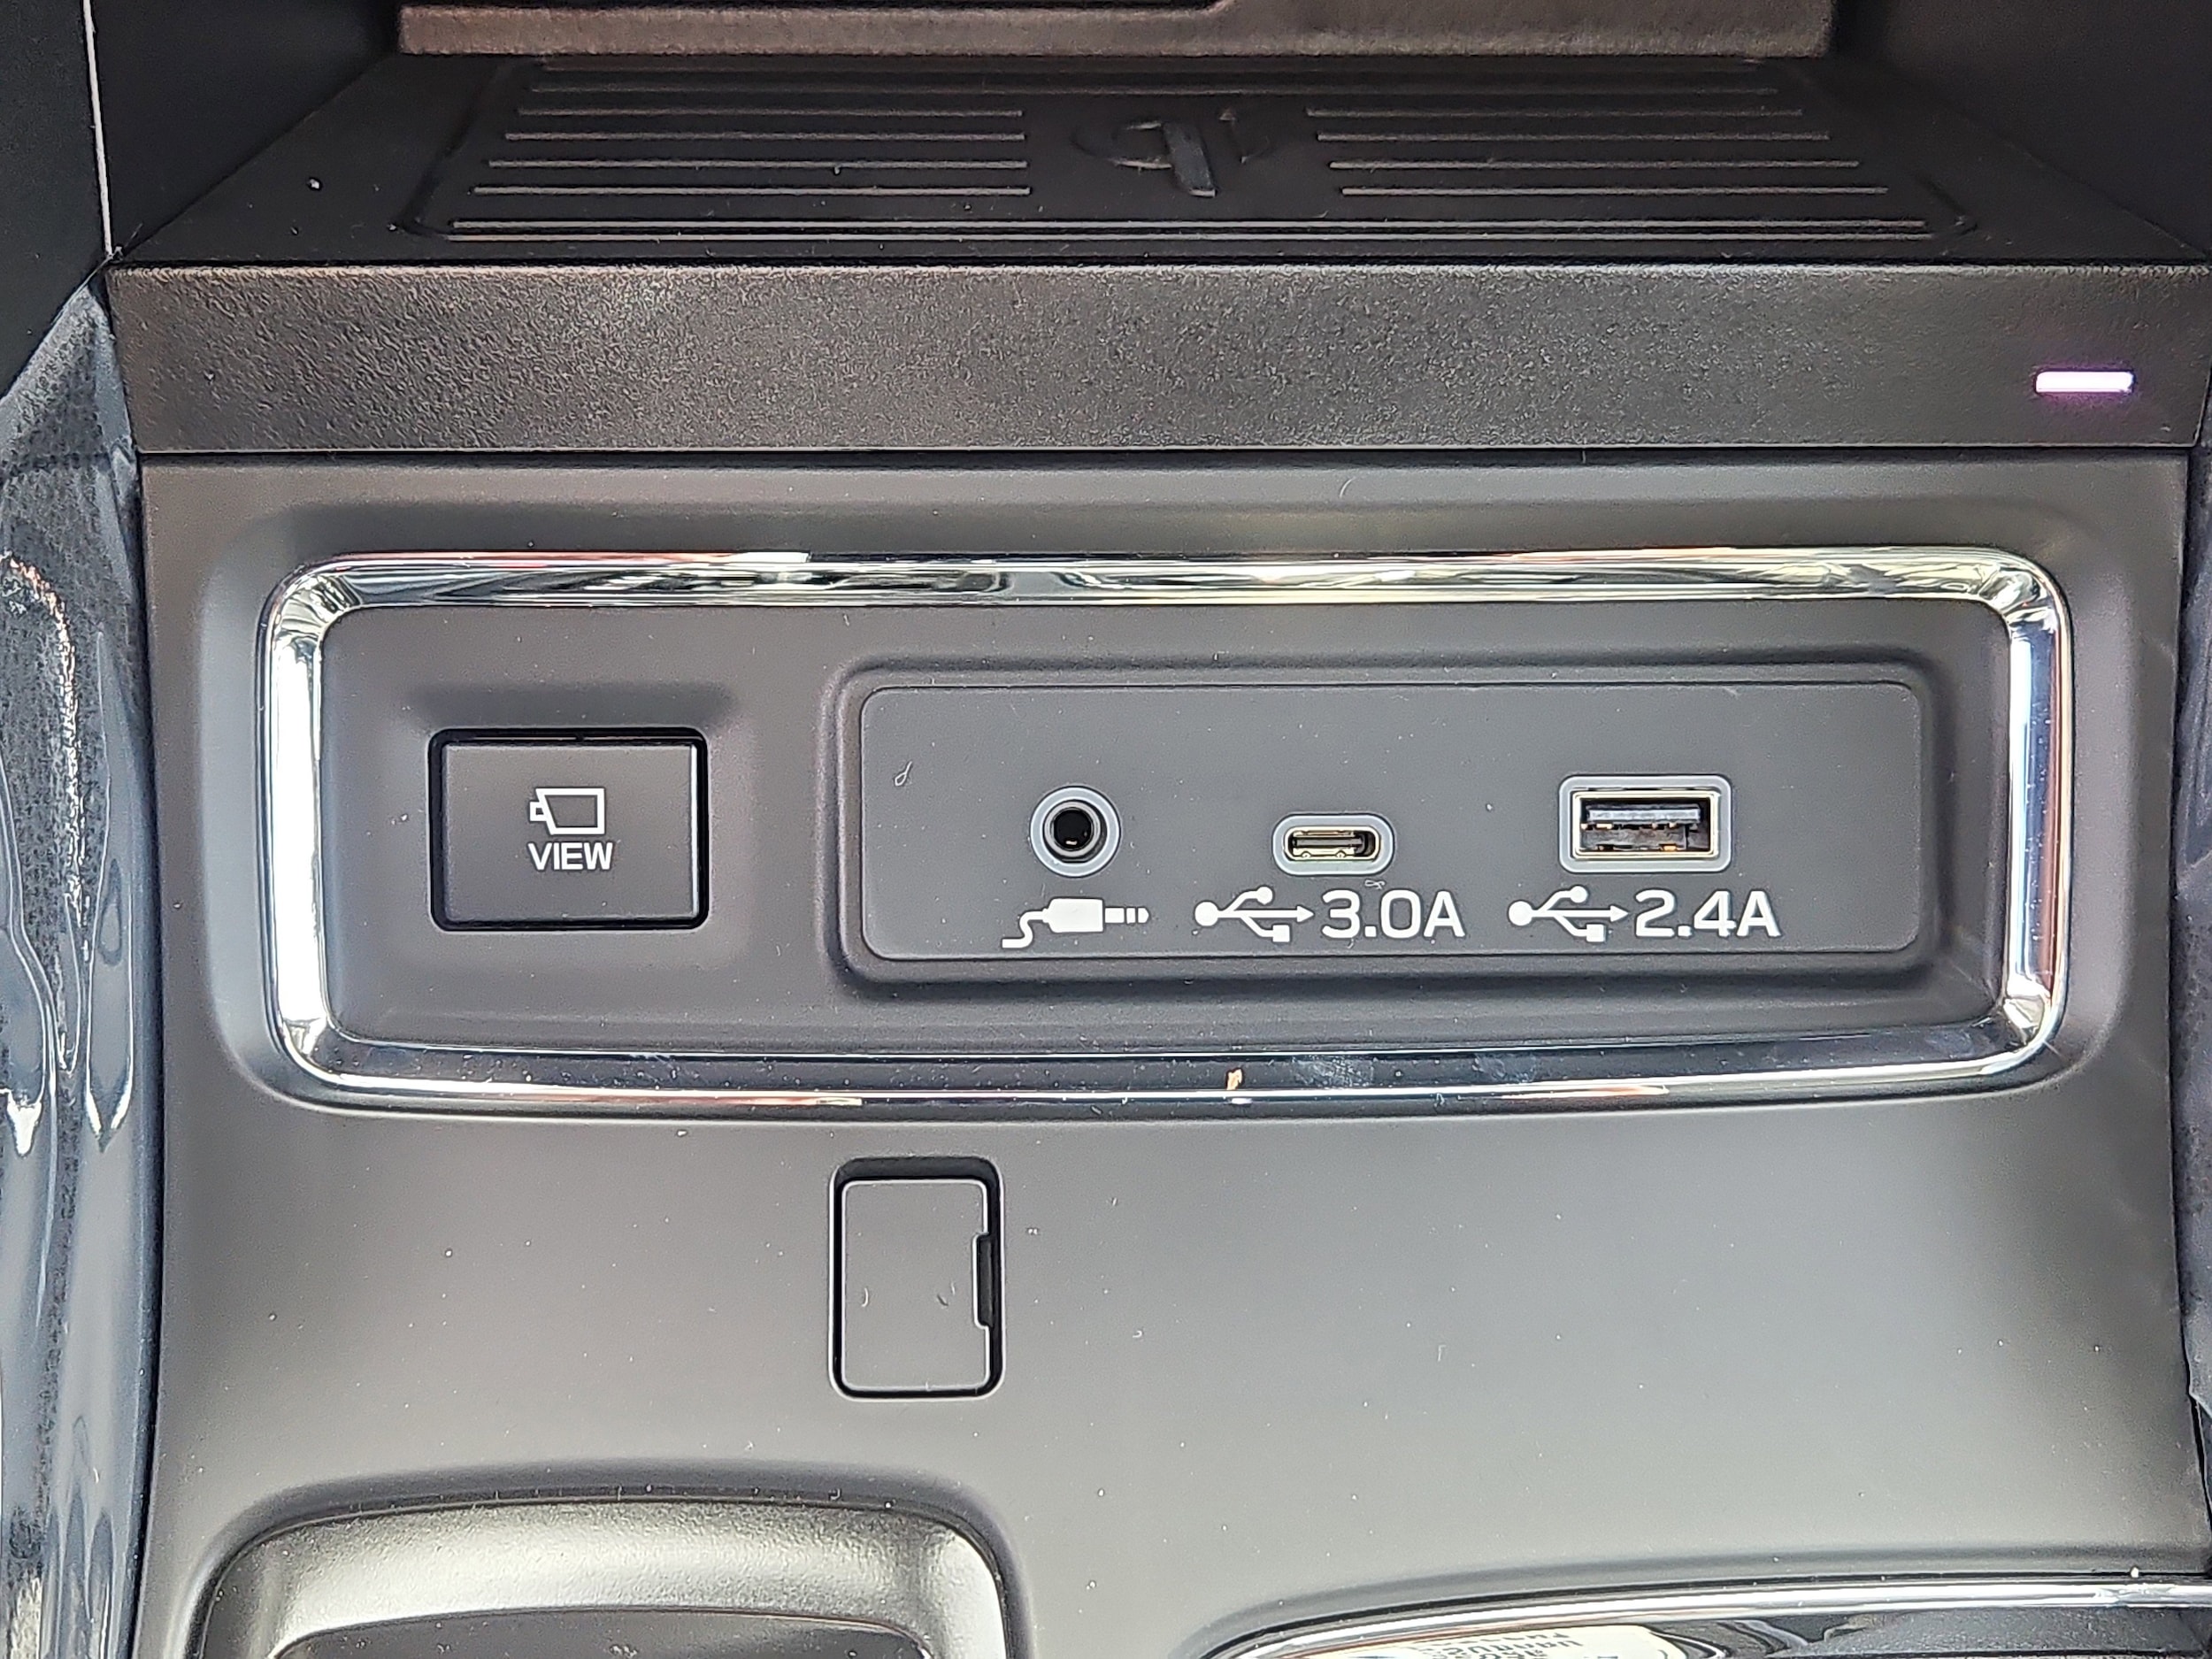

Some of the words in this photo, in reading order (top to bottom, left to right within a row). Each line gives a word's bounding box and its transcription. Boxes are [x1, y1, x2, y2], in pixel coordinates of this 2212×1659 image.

[528, 842, 613, 870] VIEW
[1322, 889, 1465, 939] 3.0A
[1635, 889, 1781, 938] 2.4A
